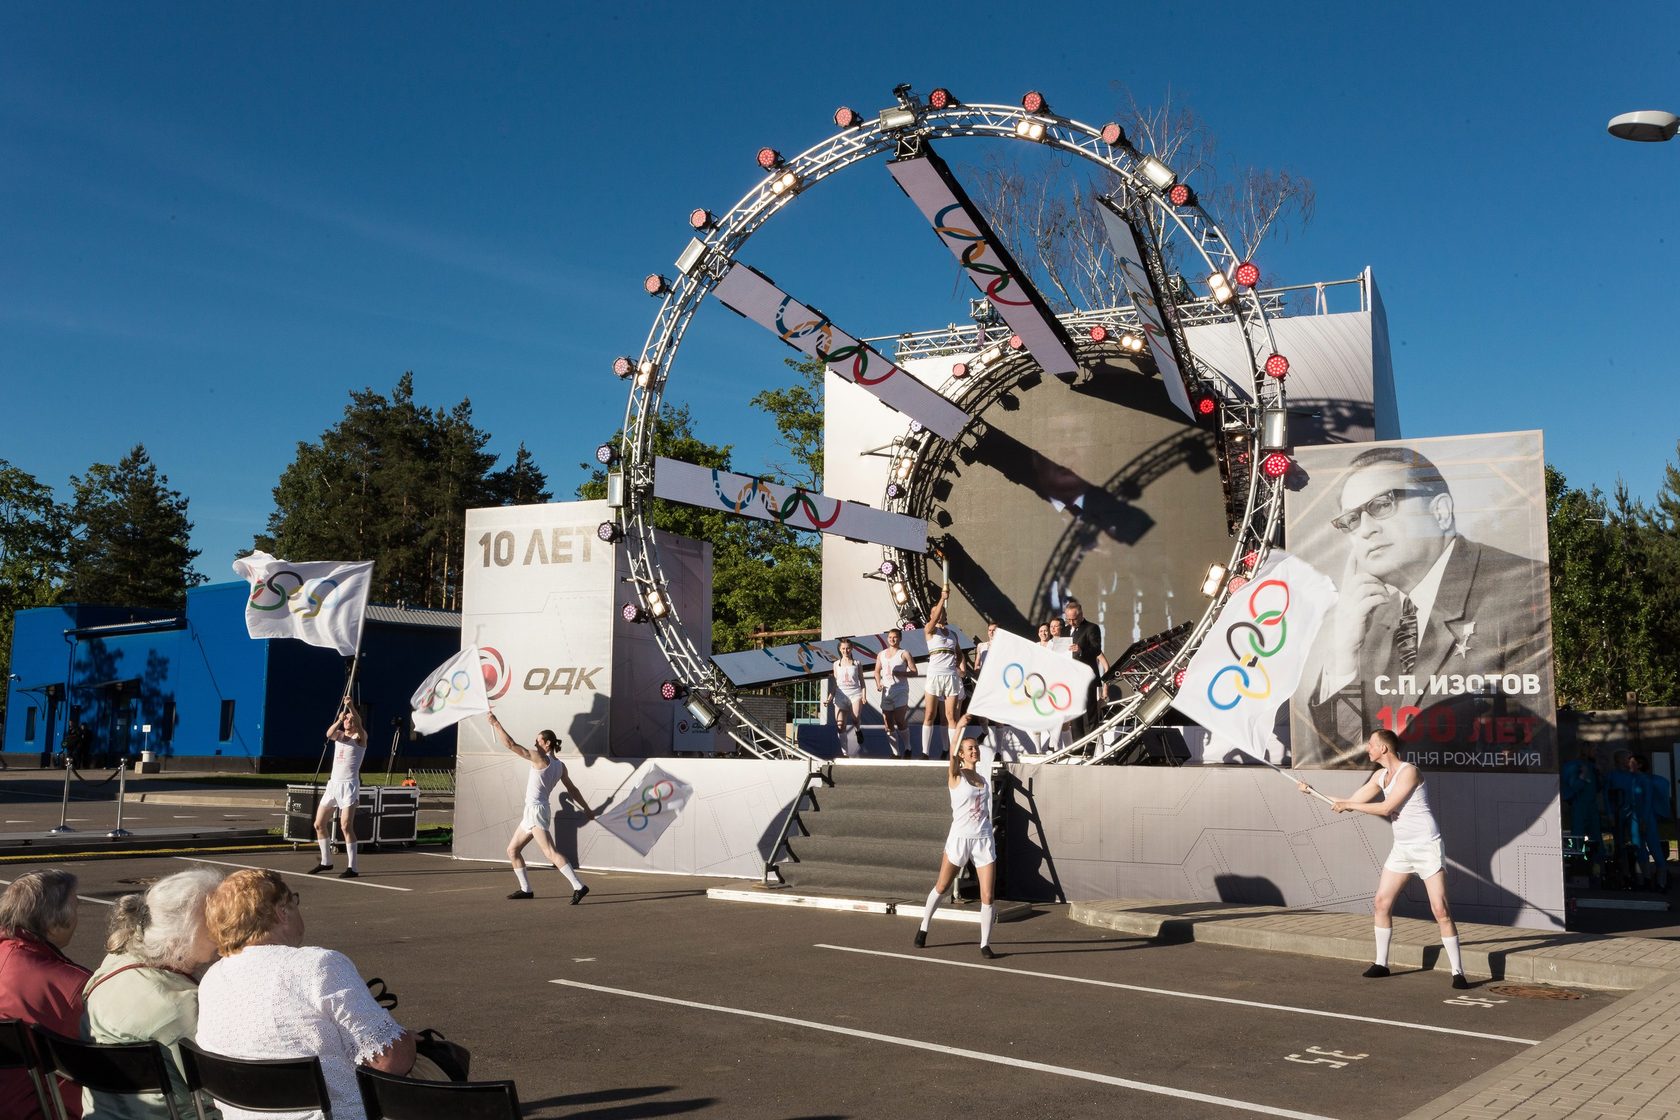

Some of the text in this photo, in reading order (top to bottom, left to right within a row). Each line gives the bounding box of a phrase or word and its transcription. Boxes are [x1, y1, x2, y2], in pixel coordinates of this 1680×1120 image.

[478, 525, 600, 567] 10 ЛЕТ
[523, 667, 604, 695] ОДК
[1374, 673, 1541, 695] С.П. ИЗОТОВ
[1376, 705, 1537, 744] 100 ЛЕТ
[1406, 752, 1439, 765] ДНЯ
[1443, 752, 1541, 767] РОЖДЕНИЯ
[1284, 1046, 1370, 1069] 35
